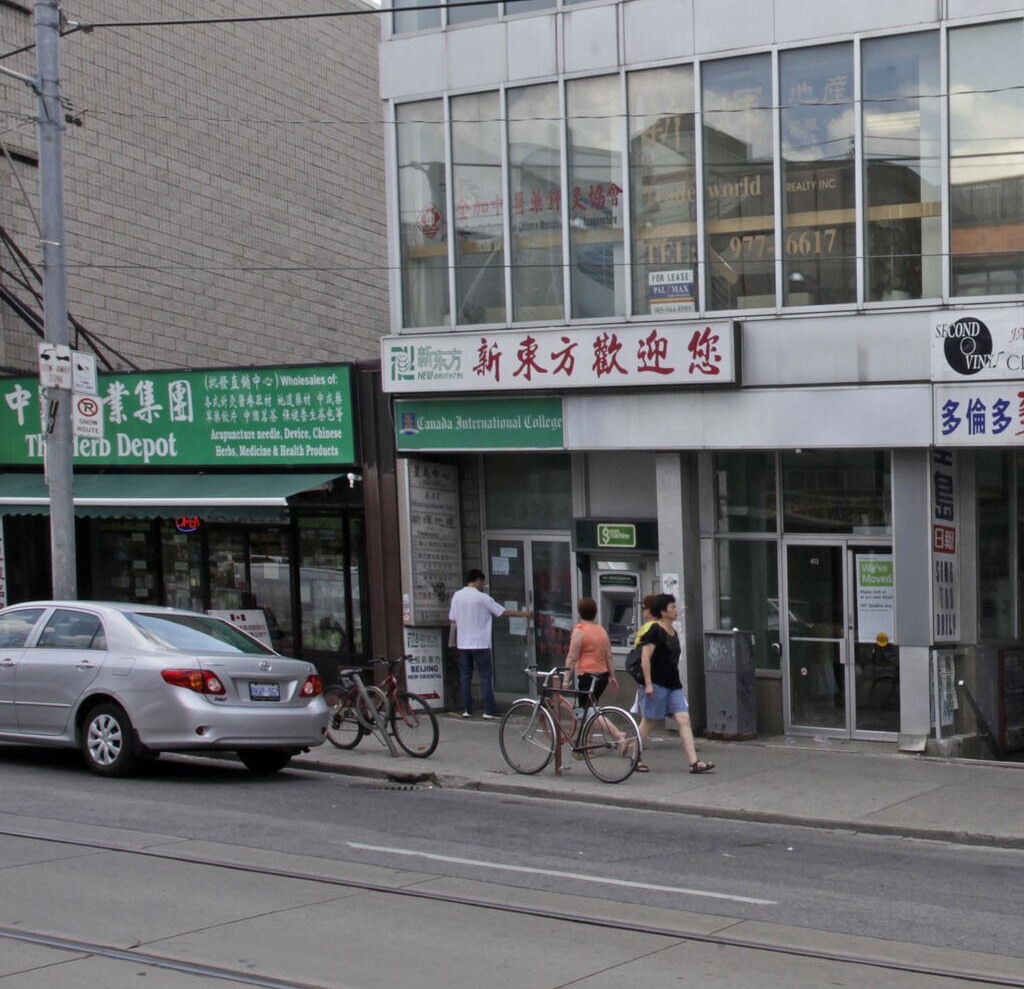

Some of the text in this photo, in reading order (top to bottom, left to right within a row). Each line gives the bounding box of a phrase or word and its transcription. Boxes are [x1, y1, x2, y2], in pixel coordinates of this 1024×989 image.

[786, 180, 817, 193] REALTY
[819, 178, 837, 190] INC
[652, 272, 689, 283] FOR LEASE
[935, 321, 980, 339] SECOND
[417, 327, 723, 382] 新东方 新東方歡迎您
[280, 373, 339, 387] Wholesales of:
[417, 371, 433, 381] NEW
[5, 379, 194, 427] 中業集團
[78, 418, 98, 426] SNOW
[416, 414, 563, 432] Canada International College
[76, 426, 99, 434] ROUTE
[211, 427, 342, 443] Acupuncture needle, Device, Chinese
[117, 432, 178, 463] Depot
[215, 444, 339, 458] Herbs, Medicine & Health Products
[861, 563, 888, 574] We've
[935, 560, 954, 584] SING
[939, 587, 954, 610] TAO
[936, 613, 957, 637] DAILY
[410, 665, 439, 673] BEIJING
